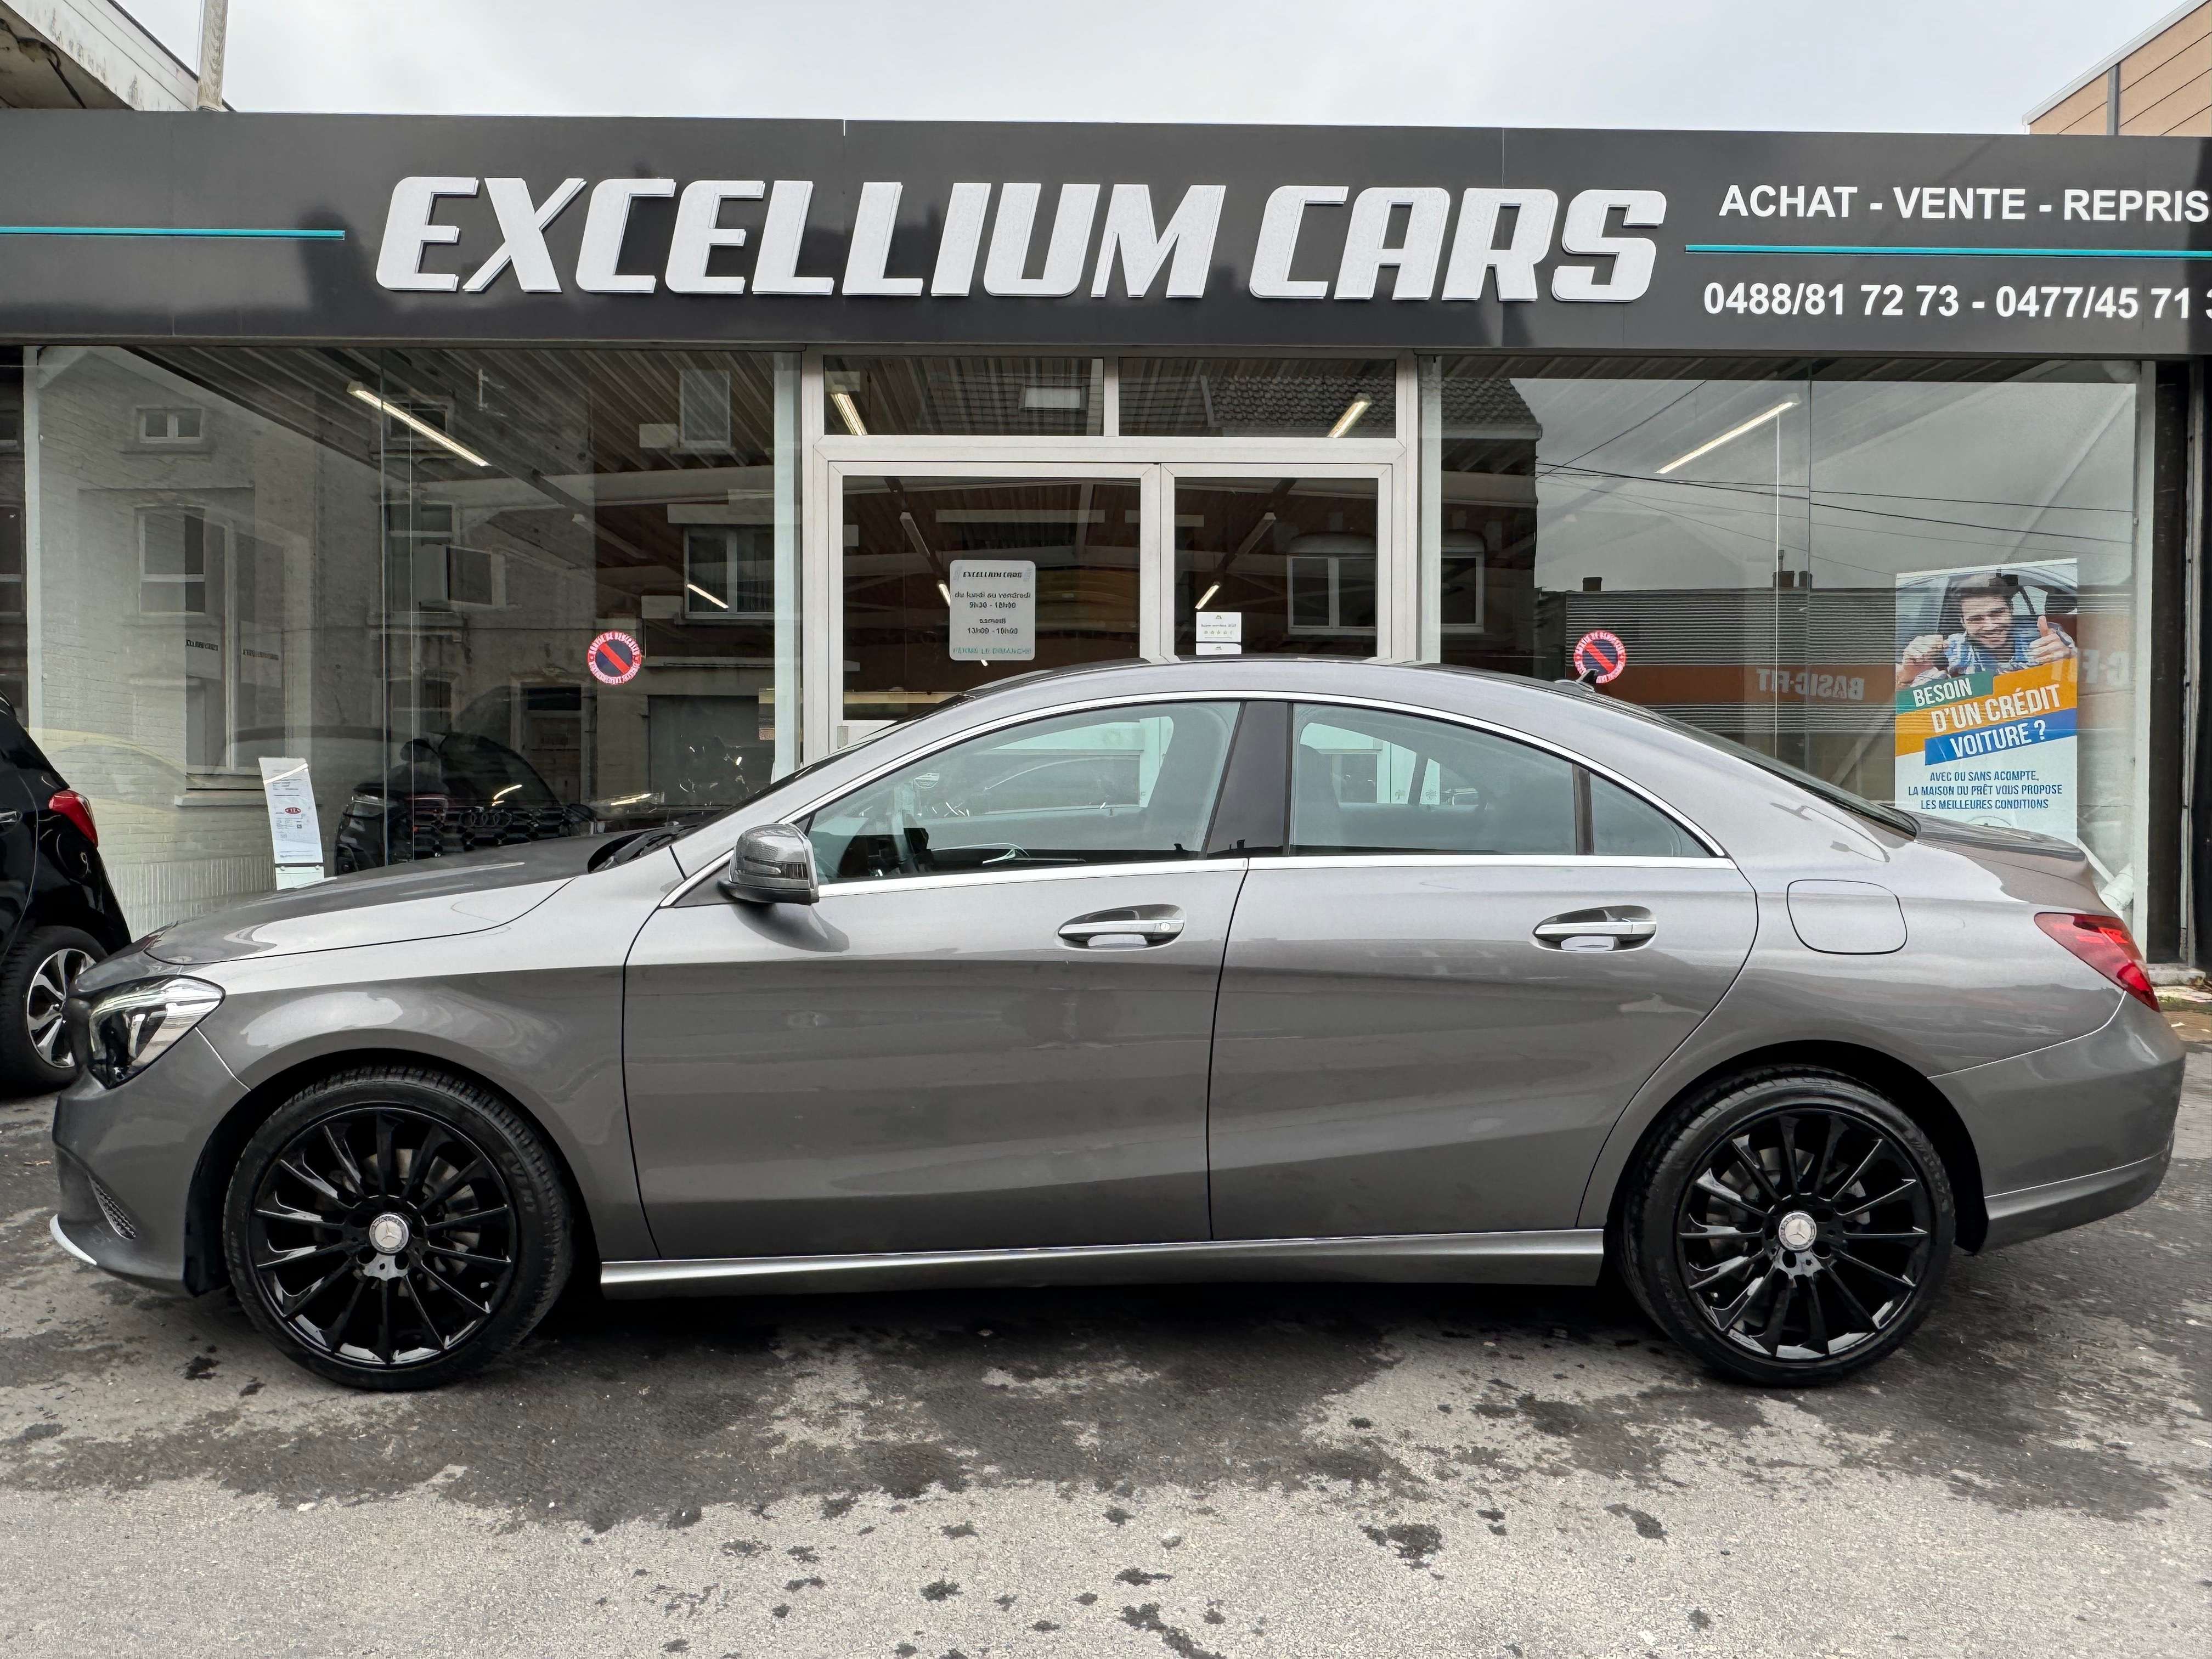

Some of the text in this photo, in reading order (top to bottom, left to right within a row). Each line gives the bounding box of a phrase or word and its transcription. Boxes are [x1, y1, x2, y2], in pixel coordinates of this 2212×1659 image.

[1719, 184, 2210, 223] ACHAT - VENTE - REPRIS
[376, 177, 1667, 302] EXCELLIUM CARS
[1704, 283, 1844, 316] 0488/81
[1860, 284, 1904, 317] 72
[1916, 285, 1960, 317] 73
[1996, 286, 2139, 319] 0477/45
[2151, 287, 2191, 319] 71
[1912, 678, 1972, 707] BESOIN
[1985, 684, 2061, 722] CRÉDIT
[1950, 719, 2046, 758] VOITURE ?
[1908, 784, 2063, 796] LA MAISON DU PRÊT VOUS PROPOSE
[1930, 771, 1951, 781] AVEC
[1954, 772, 1966, 781] OU
[1968, 771, 1991, 781] SANS
[1921, 799, 2049, 810] LES MEILLEURES CONDITIONS
